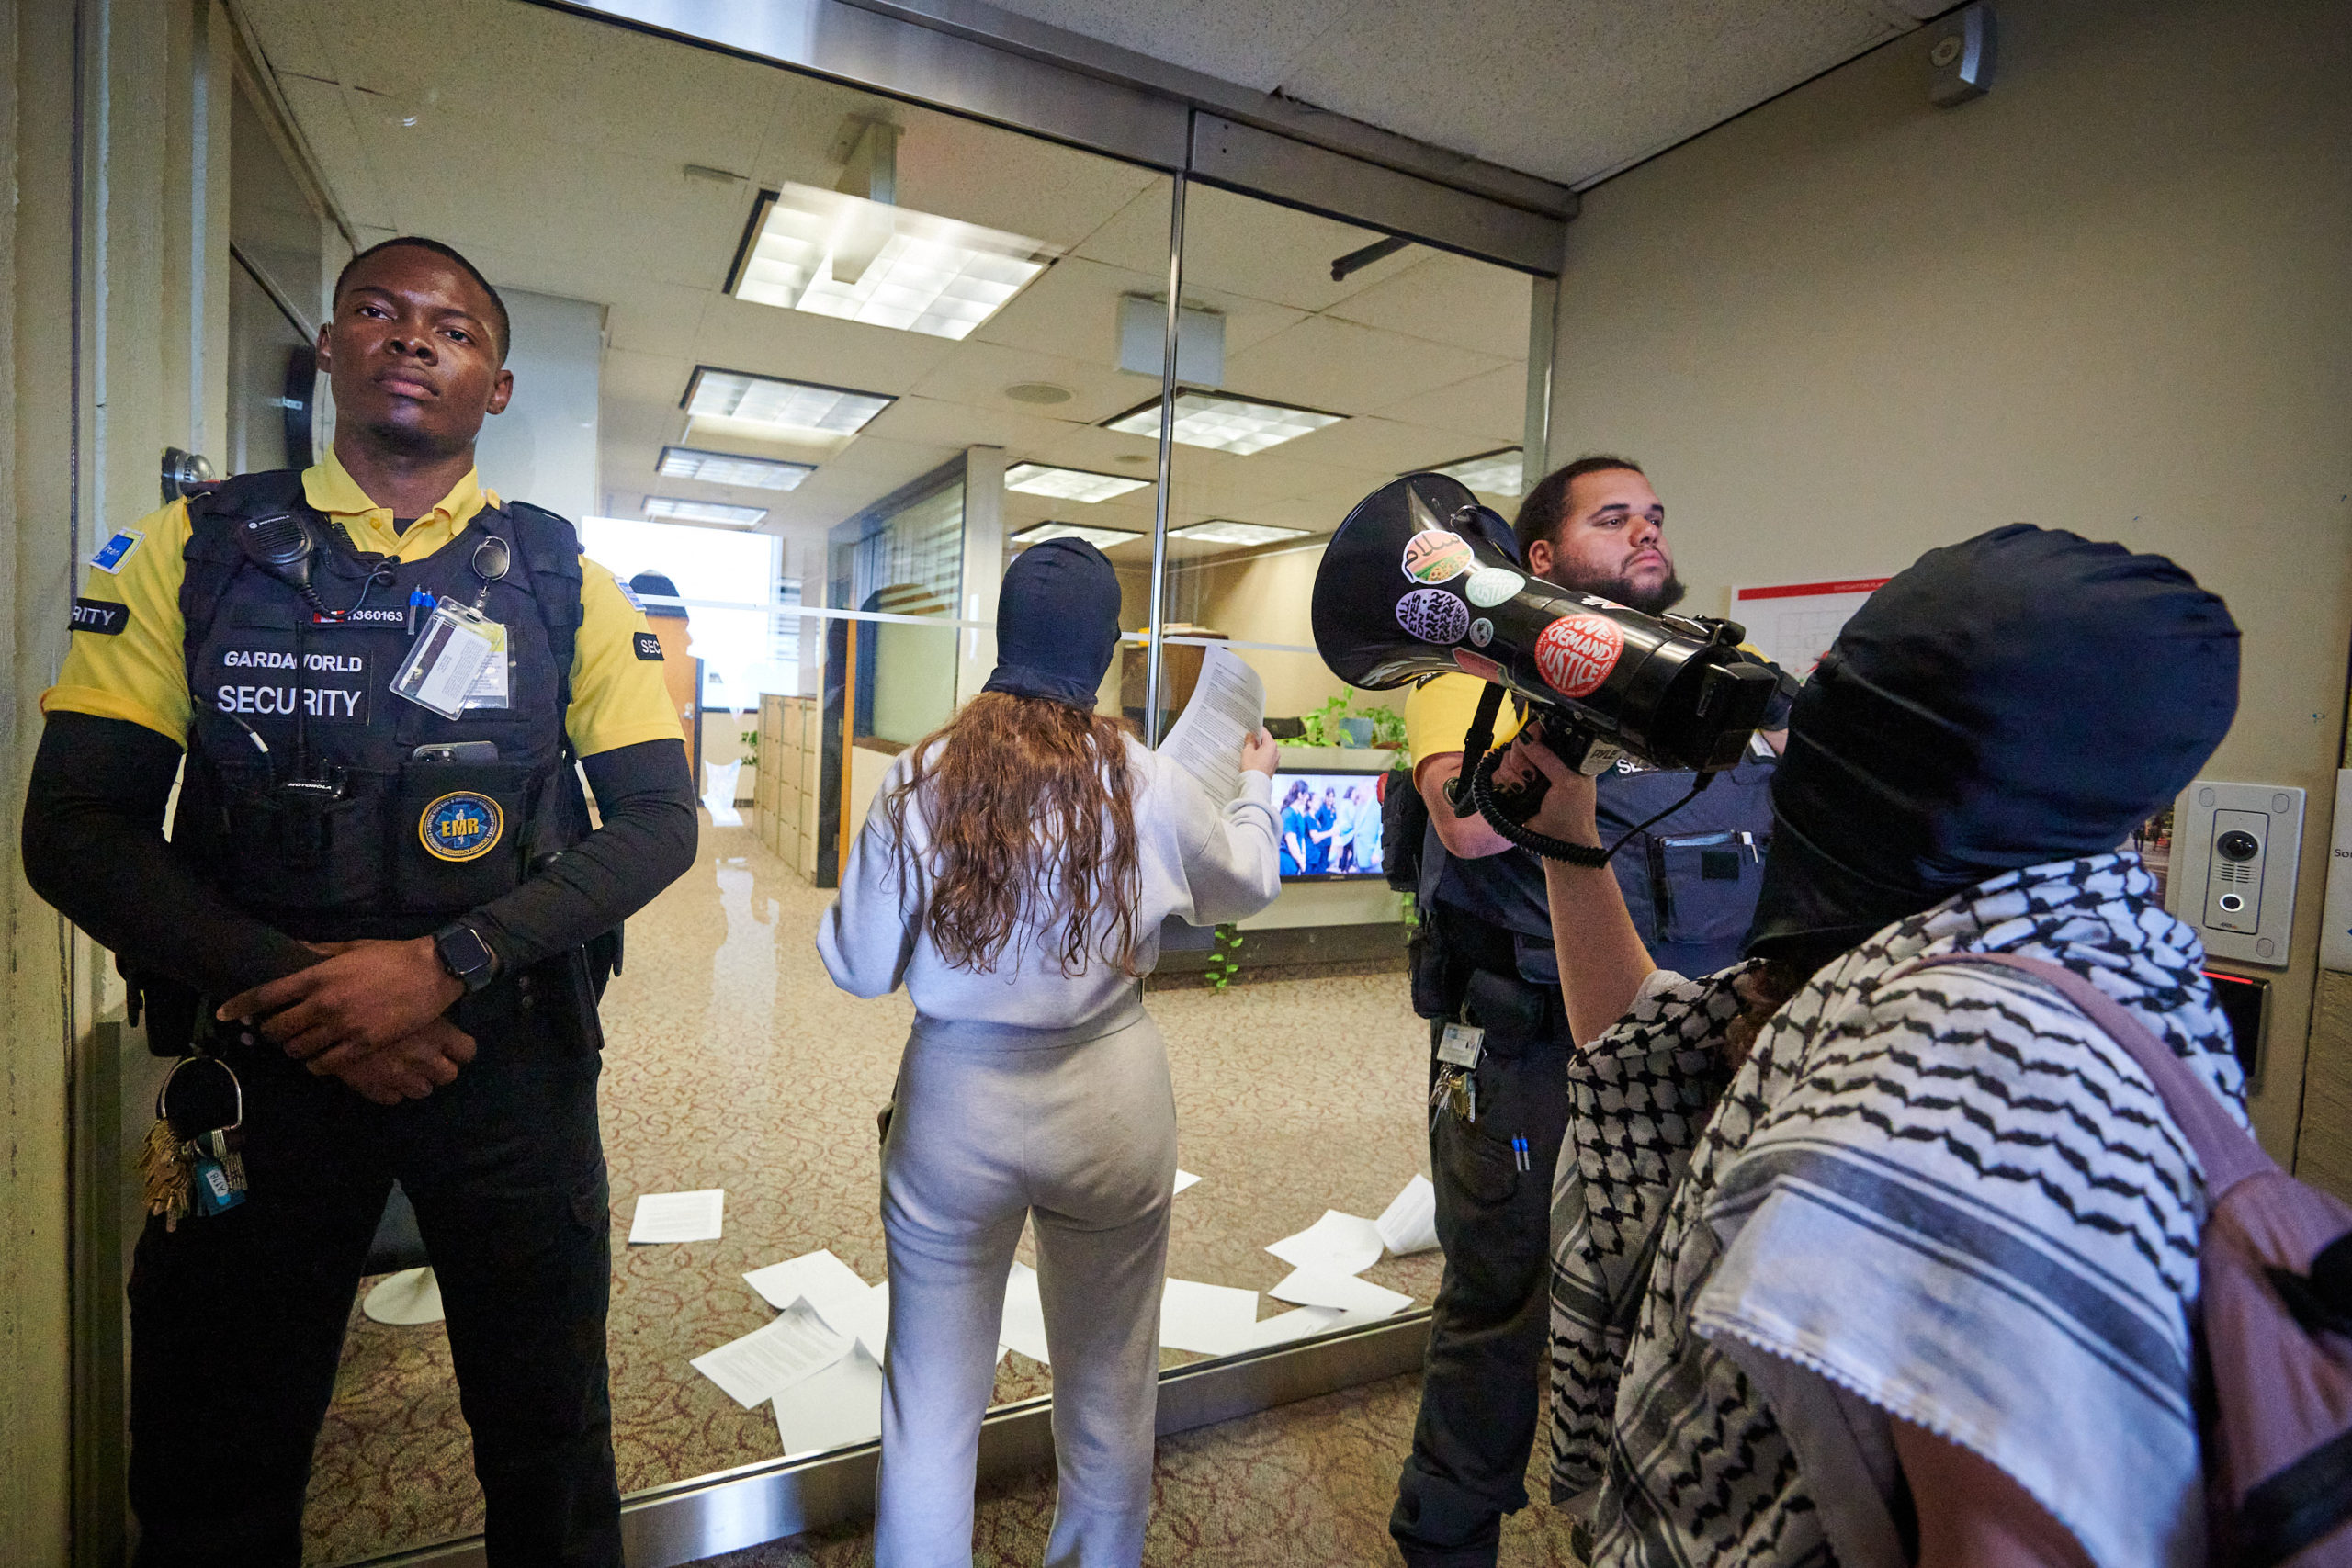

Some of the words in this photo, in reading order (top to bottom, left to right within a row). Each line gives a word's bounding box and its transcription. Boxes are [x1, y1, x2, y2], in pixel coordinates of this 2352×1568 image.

[1404, 533, 1461, 581] سلام
[1398, 599, 1410, 624] ALL
[1409, 593, 1421, 632] EYES
[1418, 613, 1424, 637] ON
[1425, 592, 1445, 641] RAFAH
[1548, 626, 1612, 661] DEMAND
[1574, 620, 1611, 640] WE
[1542, 644, 1600, 689] JUSTICE
[218, 685, 361, 717] SECURITY
[1590, 749, 1621, 759] PYLE
[441, 818, 479, 837] EMR
[2335, 848, 2352, 859] So
